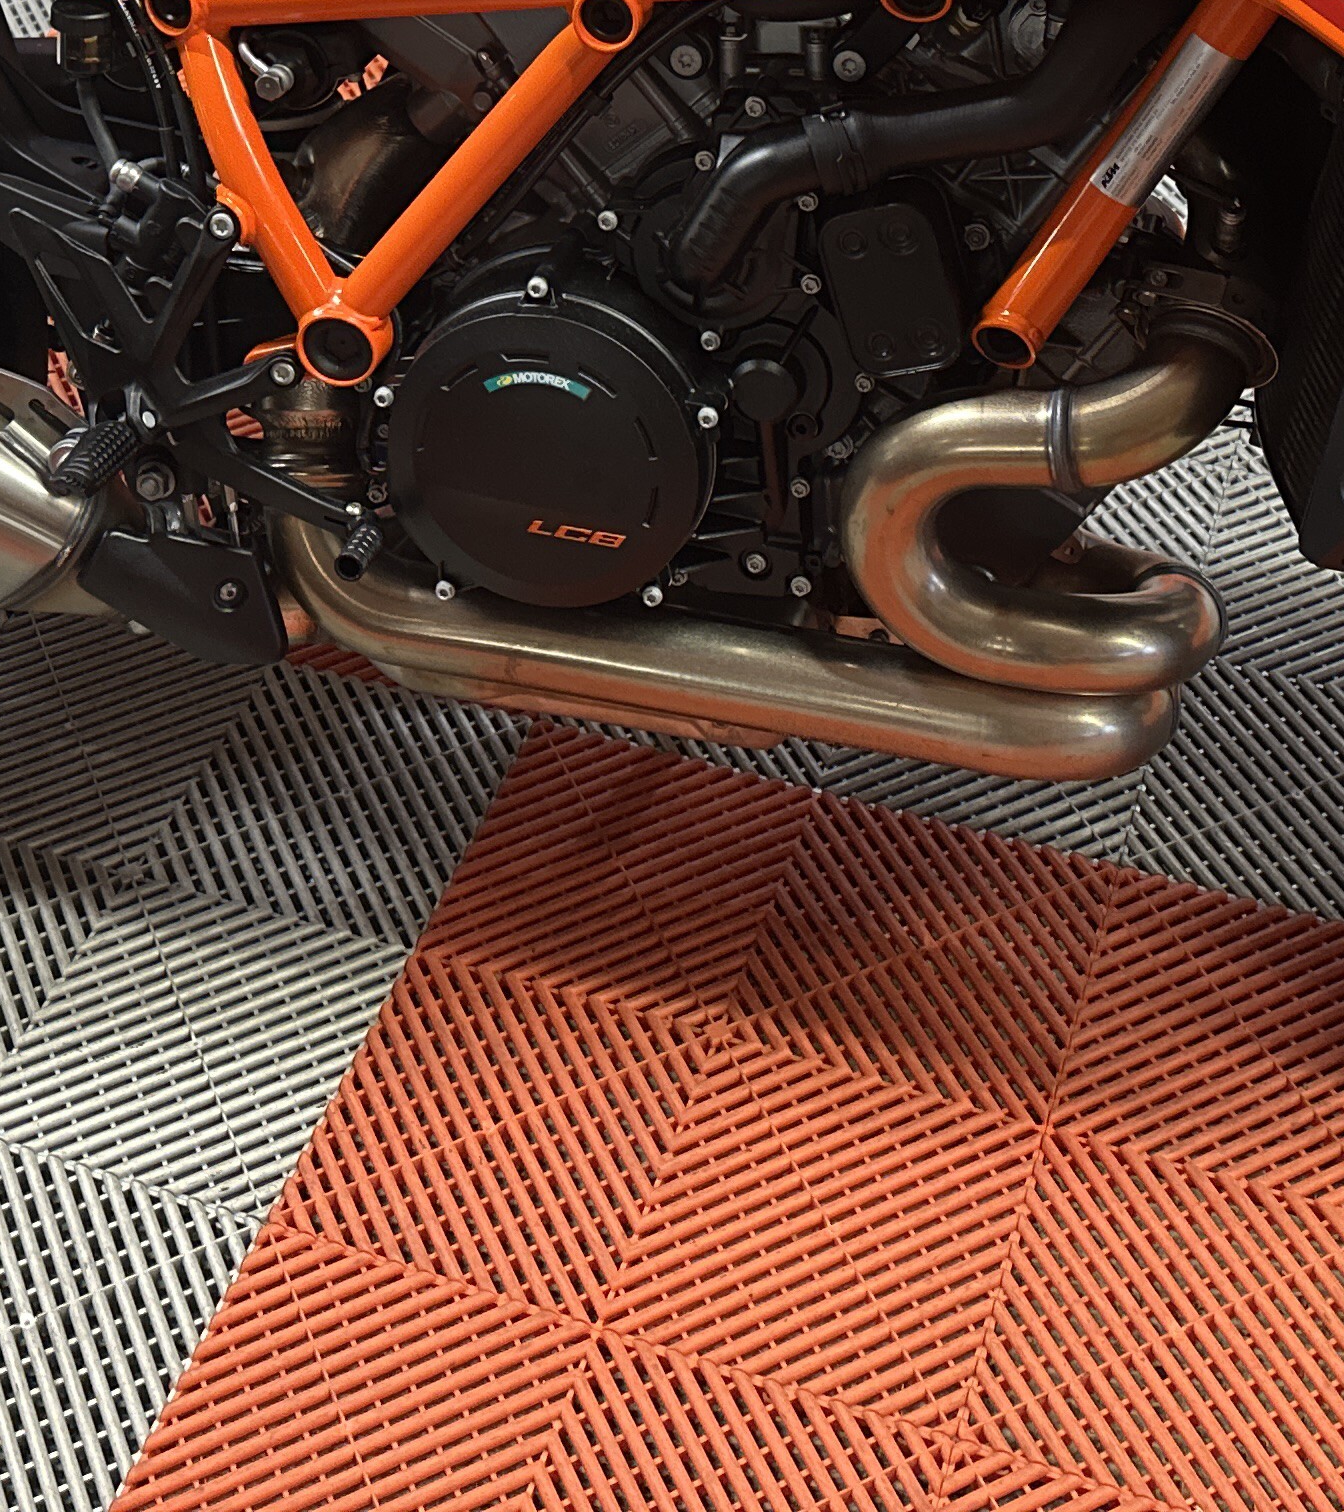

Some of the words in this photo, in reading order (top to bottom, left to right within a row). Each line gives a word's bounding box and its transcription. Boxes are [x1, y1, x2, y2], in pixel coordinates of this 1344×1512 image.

[1101, 162, 1120, 189] KTM
[512, 371, 571, 391] MOTOREX
[526, 519, 627, 549] LC8
